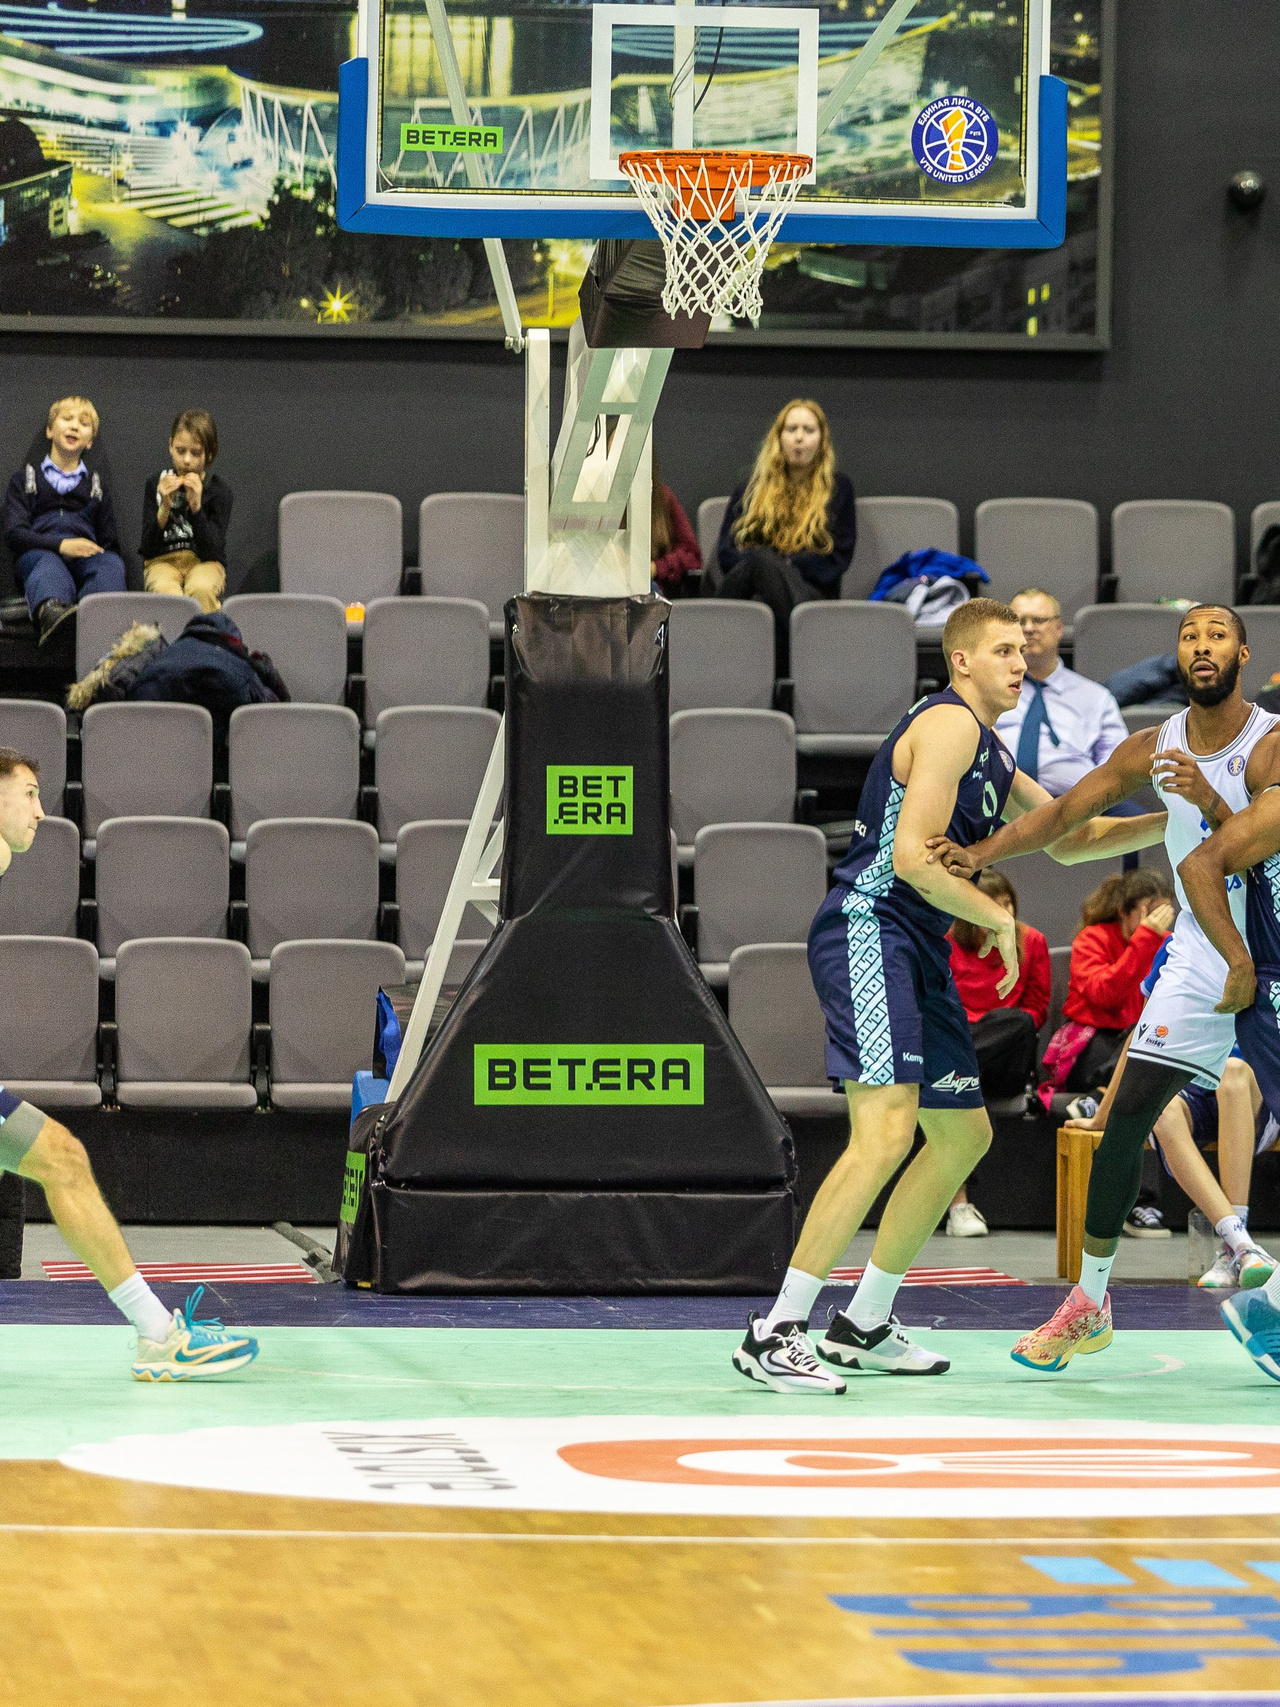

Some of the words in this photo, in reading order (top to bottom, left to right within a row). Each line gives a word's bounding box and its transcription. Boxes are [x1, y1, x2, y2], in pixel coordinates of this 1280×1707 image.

[917, 99, 949, 126] ЕДИНАЯ
[951, 97, 974, 110] ЛИГА
[975, 106, 990, 122] ВТБ
[919, 157, 933, 173] VTB
[933, 169, 964, 183] UNITED
[965, 153, 993, 181] LEAGUE
[558, 775, 626, 798] BET
